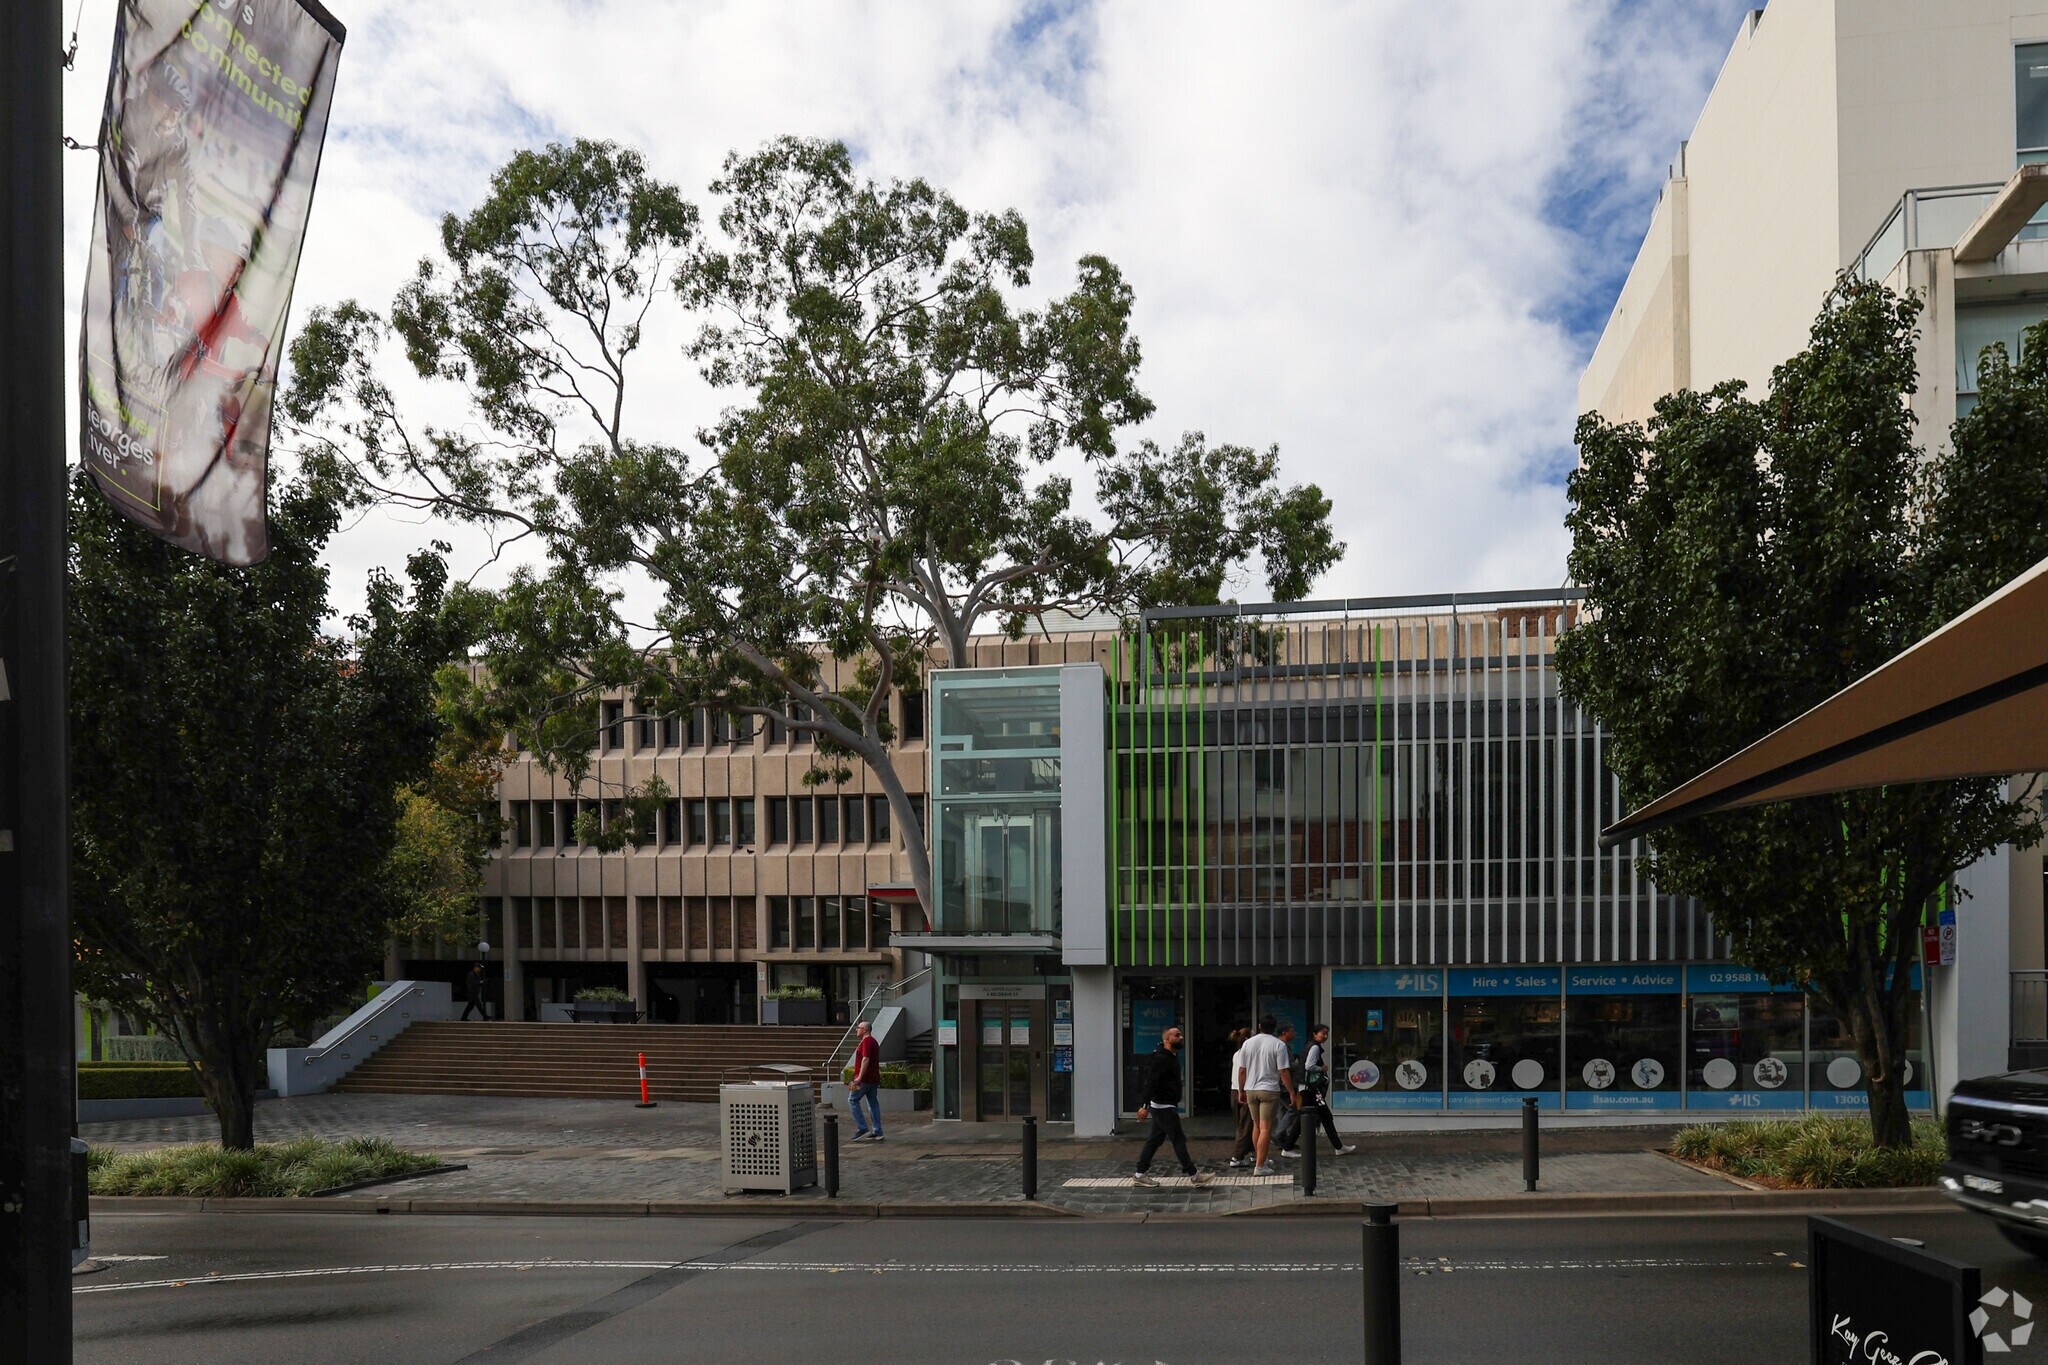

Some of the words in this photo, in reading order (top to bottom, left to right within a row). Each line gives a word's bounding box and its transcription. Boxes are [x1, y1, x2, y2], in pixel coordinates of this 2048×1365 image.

[182, 18, 302, 133] communit
[87, 398, 154, 466] eorges
[1414, 974, 1438, 992] ILS
[1472, 977, 1498, 988] Hire
[1515, 976, 1547, 987] Sales
[1571, 975, 1617, 986] Service
[1632, 974, 1674, 986] Advice
[1709, 973, 1723, 983] 02
[1725, 973, 1752, 983] 9588
[1754, 973, 1769, 982] 14
[1501, 1096, 1523, 1104] Specia
[1593, 1095, 1654, 1104] ilsau.com.au
[1743, 1094, 1761, 1107] ILS
[1834, 1095, 1860, 1105] 1300
[1831, 1311, 1860, 1360] Kay
